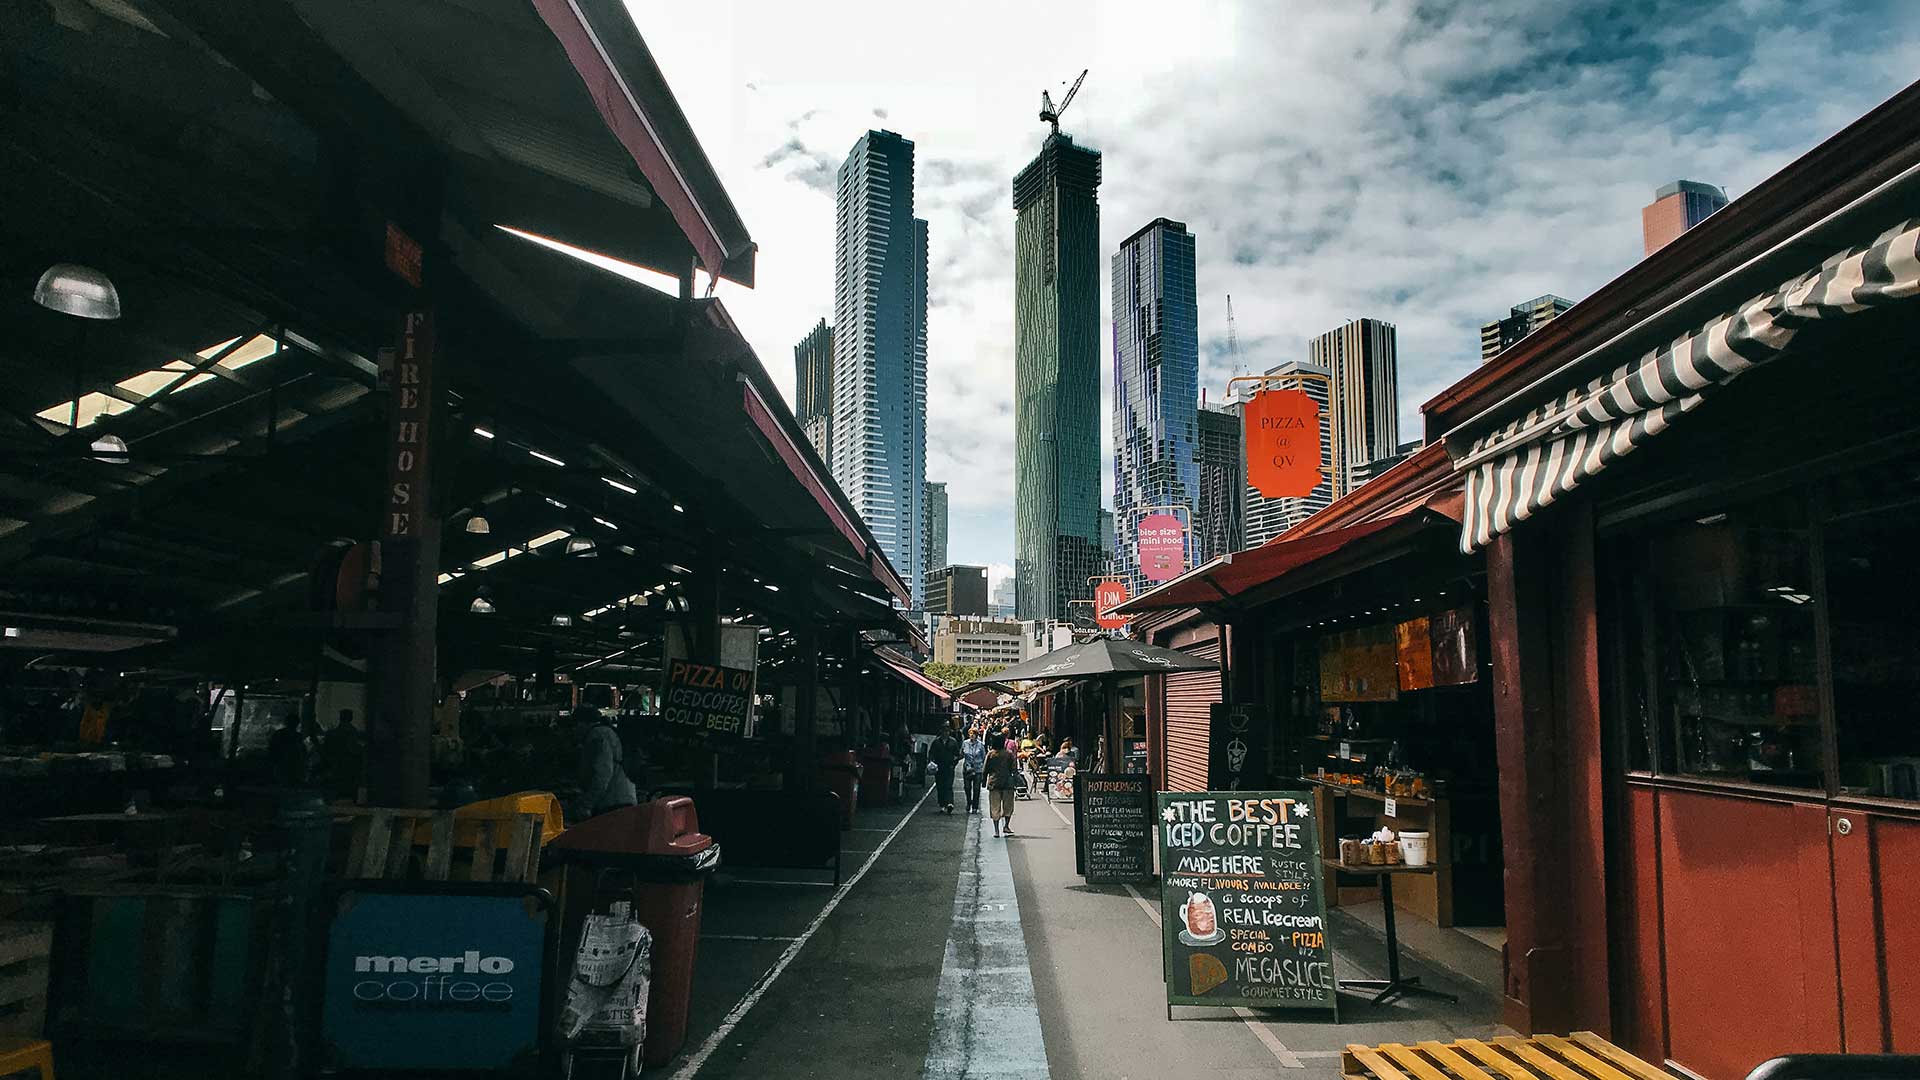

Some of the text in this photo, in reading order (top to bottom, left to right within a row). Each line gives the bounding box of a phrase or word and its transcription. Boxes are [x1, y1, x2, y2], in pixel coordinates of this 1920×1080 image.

[399, 312, 424, 409] FIRE
[1261, 417, 1305, 429] PIZZA
[1275, 435, 1291, 449] @
[1272, 455, 1295, 470] QV
[391, 420, 419, 536] HOSE
[1139, 528, 1177, 536] bite size
[1140, 537, 1183, 545] mini food
[1103, 591, 1121, 606] DIM
[671, 662, 725, 689] PIZZA
[668, 688, 702, 708] ICED
[664, 706, 741, 734] COLD BEER
[1088, 781, 1143, 793] HOT BEVERAGES
[1170, 799, 1295, 826] THE BEST
[1166, 822, 1302, 849] ICED COFFEE
[1177, 855, 1265, 875] MADE HERE
[1200, 877, 1250, 891] FLAVOURS
[1240, 893, 1283, 909] scoops
[1291, 894, 1309, 908] of
[1223, 908, 1324, 931] REAL Icecream
[1229, 928, 1271, 941] SPECIAL
[1291, 931, 1325, 950] PIZZA
[1231, 941, 1274, 954] COMBO
[354, 950, 515, 975] merlo
[353, 975, 514, 1002] coffee
[1293, 987, 1325, 1001] STYLE
